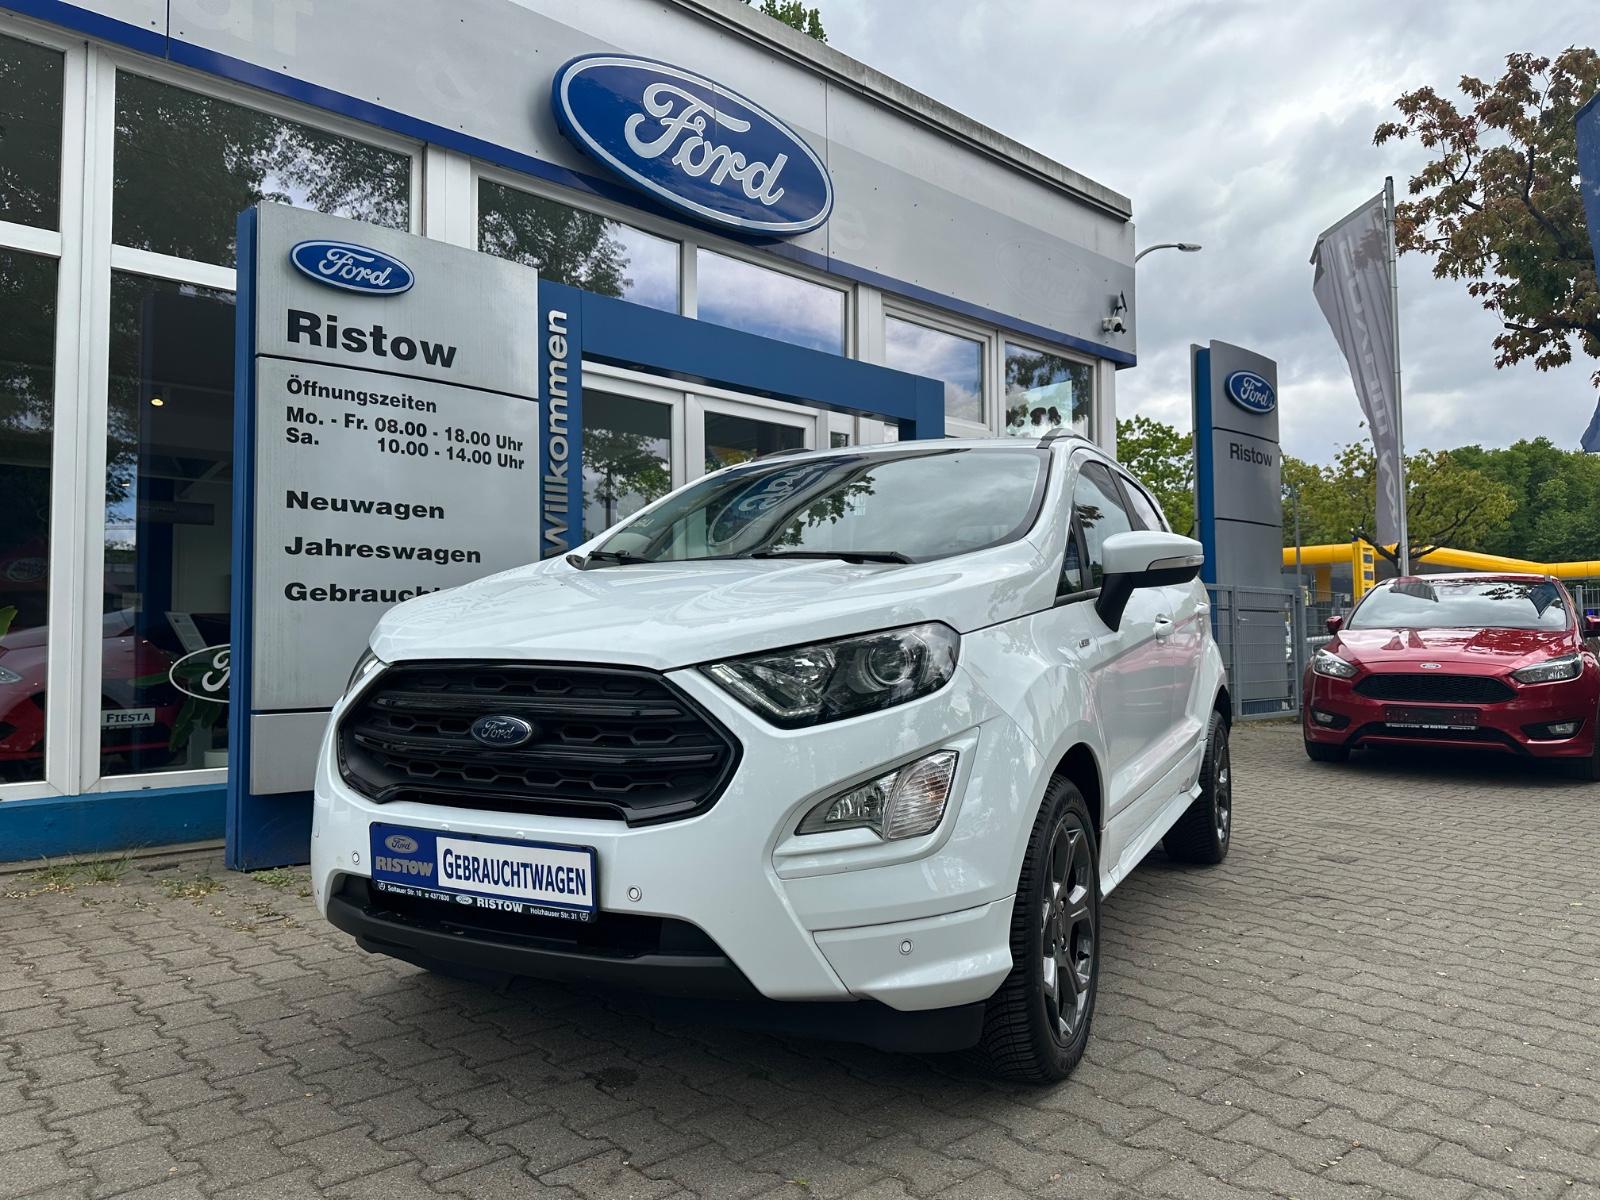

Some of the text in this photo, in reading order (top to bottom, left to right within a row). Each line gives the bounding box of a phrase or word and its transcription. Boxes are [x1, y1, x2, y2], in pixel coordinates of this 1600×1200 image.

[624, 82, 789, 206] Ford
[318, 248, 393, 287] Ford
[287, 308, 457, 368] Ristow
[286, 374, 437, 413] Öffnungszeiten
[1240, 377, 1269, 407] Ford
[286, 406, 324, 425] Mo.
[344, 413, 368, 430] Fr.
[374, 417, 428, 437] 08.00
[445, 427, 491, 446] 18.00
[496, 434, 523, 451] Uhr
[543, 309, 568, 558] Willkommen
[286, 427, 319, 445] Sa.
[378, 437, 429, 457] 10.00
[446, 446, 492, 465] 14.00
[497, 453, 525, 469] Uhr
[1229, 443, 1273, 467] Ristow
[286, 490, 445, 520] Neuwagen
[284, 536, 481, 565] Jahreswagen
[106, 713, 151, 723] FIESTA
[481, 720, 515, 739] Ford
[390, 838, 411, 851] Ford
[375, 856, 433, 877] RISTOW
[442, 848, 587, 896] GEBRAUCHTWAGEN
[476, 898, 523, 913] RISTOW
[530, 907, 578, 920] Holzhauser Str. 31
